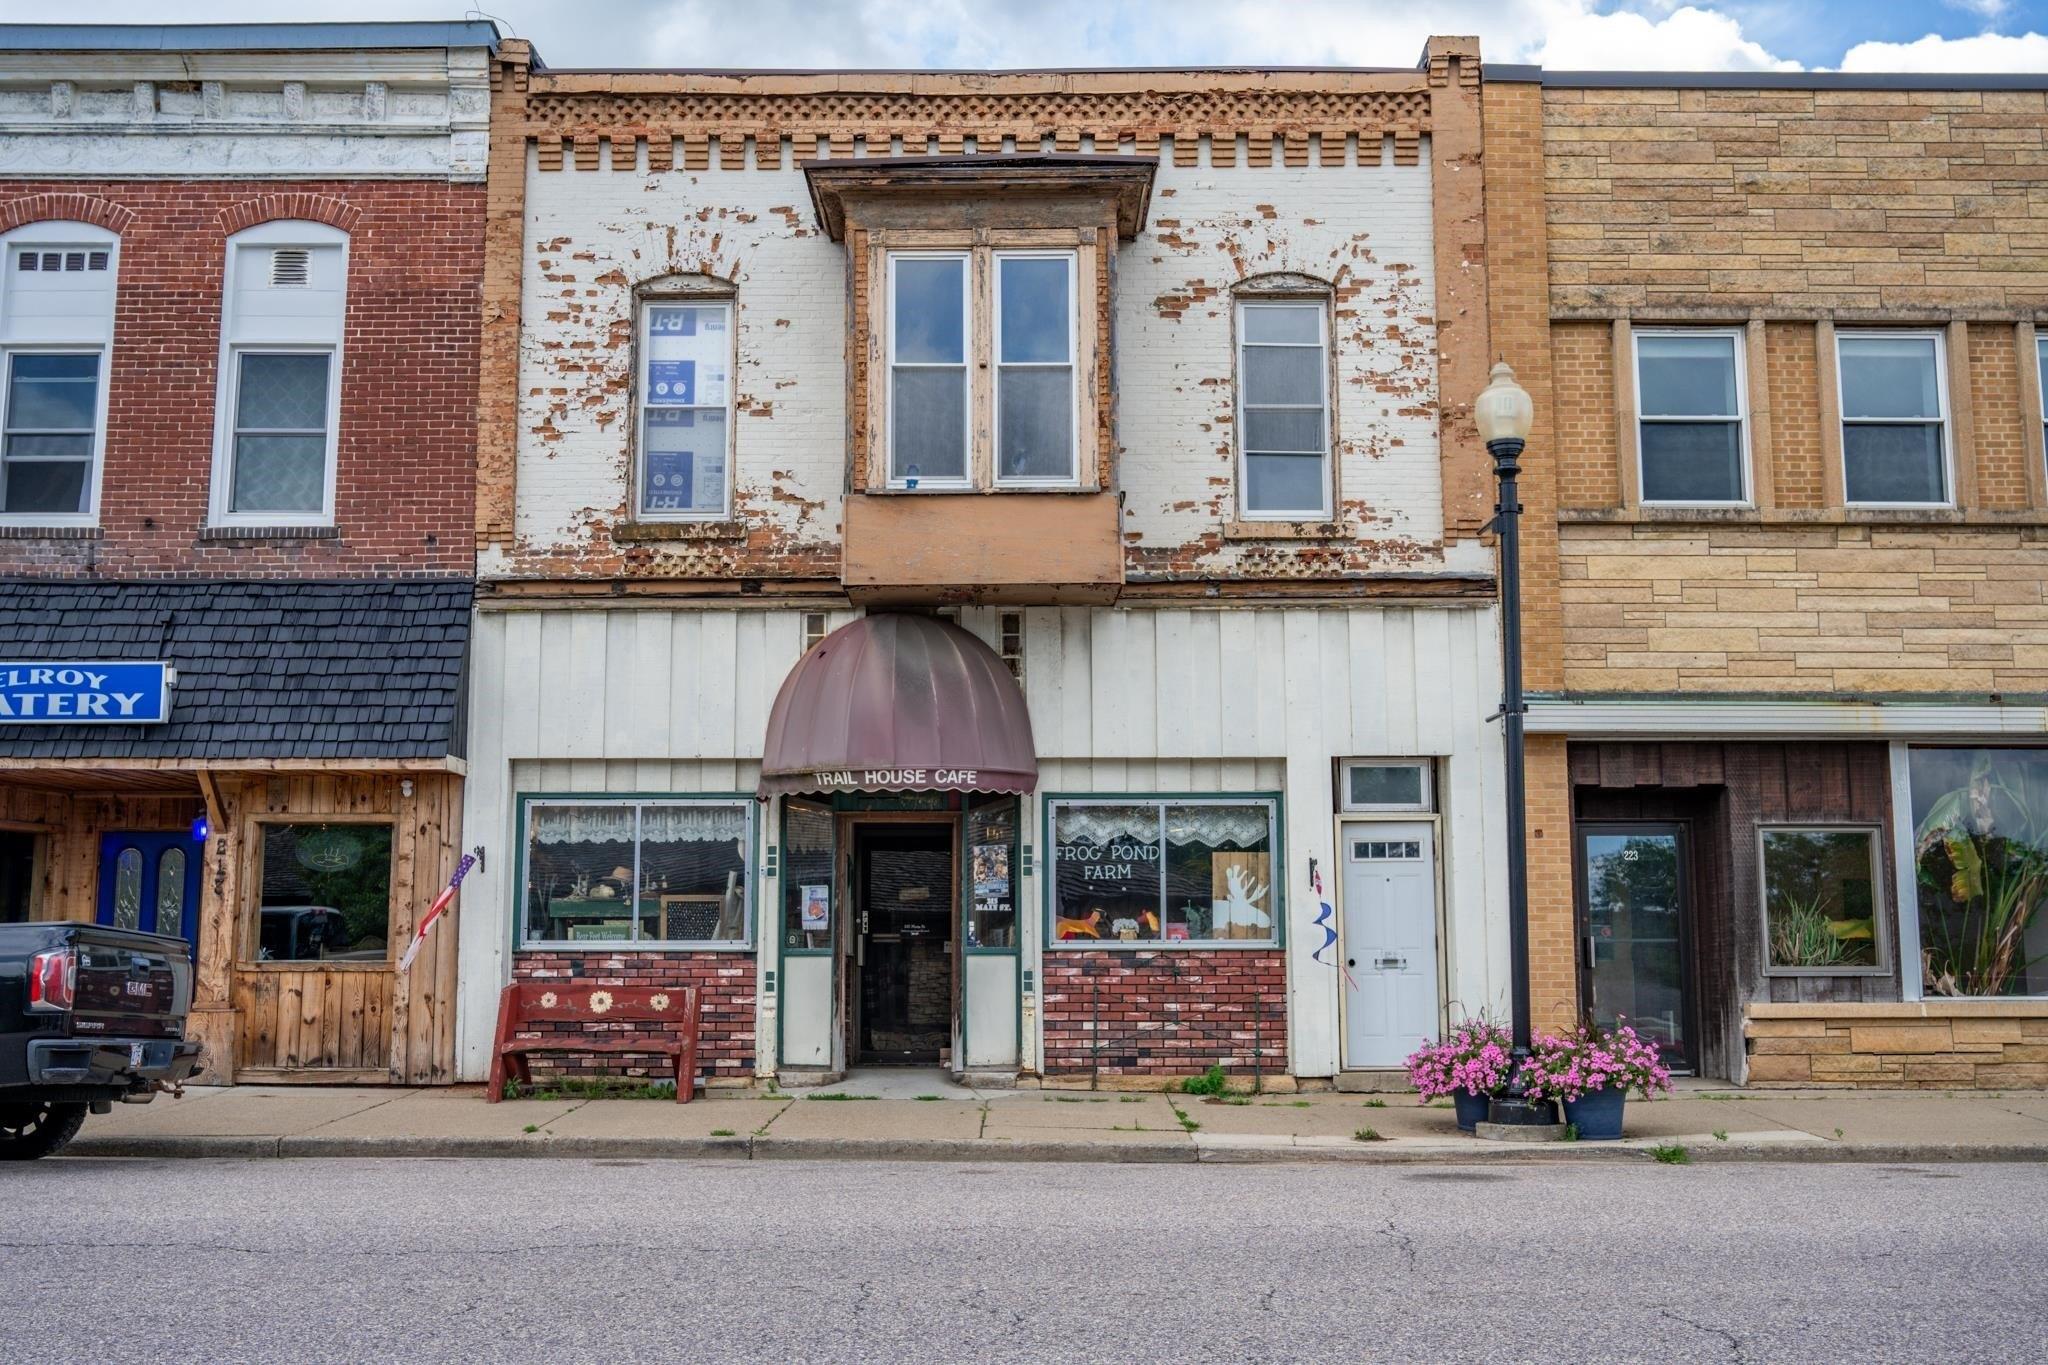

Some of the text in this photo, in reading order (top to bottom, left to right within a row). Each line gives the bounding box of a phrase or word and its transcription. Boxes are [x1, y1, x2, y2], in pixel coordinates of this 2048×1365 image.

[813, 769, 977, 786] TRAIL HOUSE CAFE
[1056, 844, 1160, 861] FROG POND
[1623, 850, 1639, 861] 223
[1083, 864, 1132, 880] FARM
[975, 903, 998, 911] MAIN
[127, 981, 153, 997] GMC
